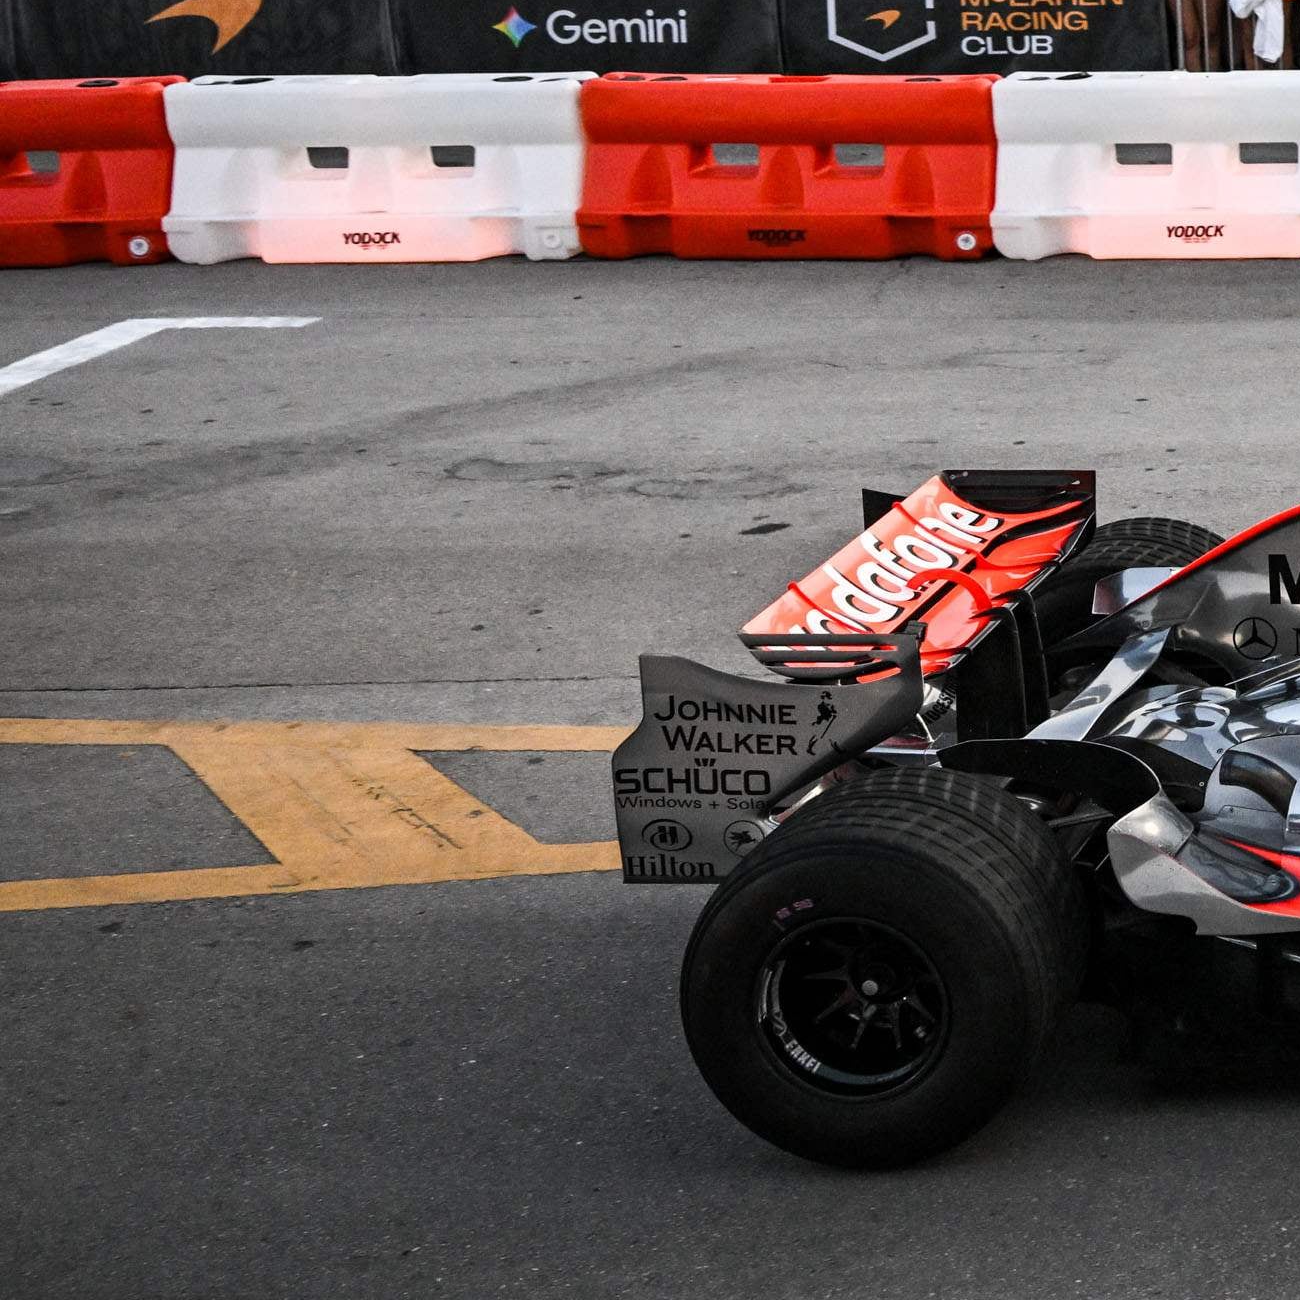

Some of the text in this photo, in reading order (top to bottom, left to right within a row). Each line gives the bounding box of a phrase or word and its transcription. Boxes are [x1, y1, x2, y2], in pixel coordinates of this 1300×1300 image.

[546, 8, 688, 45] Gemini
[961, 10, 1089, 31] RACING
[961, 35, 1053, 56] CLUB
[343, 232, 401, 245] YODOCK
[1166, 225, 1225, 238] YODOCK
[788, 502, 1001, 636] odafone
[654, 695, 798, 726] JOHNNIE
[661, 724, 799, 756] WALKER
[614, 758, 772, 796] SCHÜCO
[618, 796, 703, 810] Windows
[730, 796, 769, 811] Sola
[624, 854, 715, 878] Hilton
